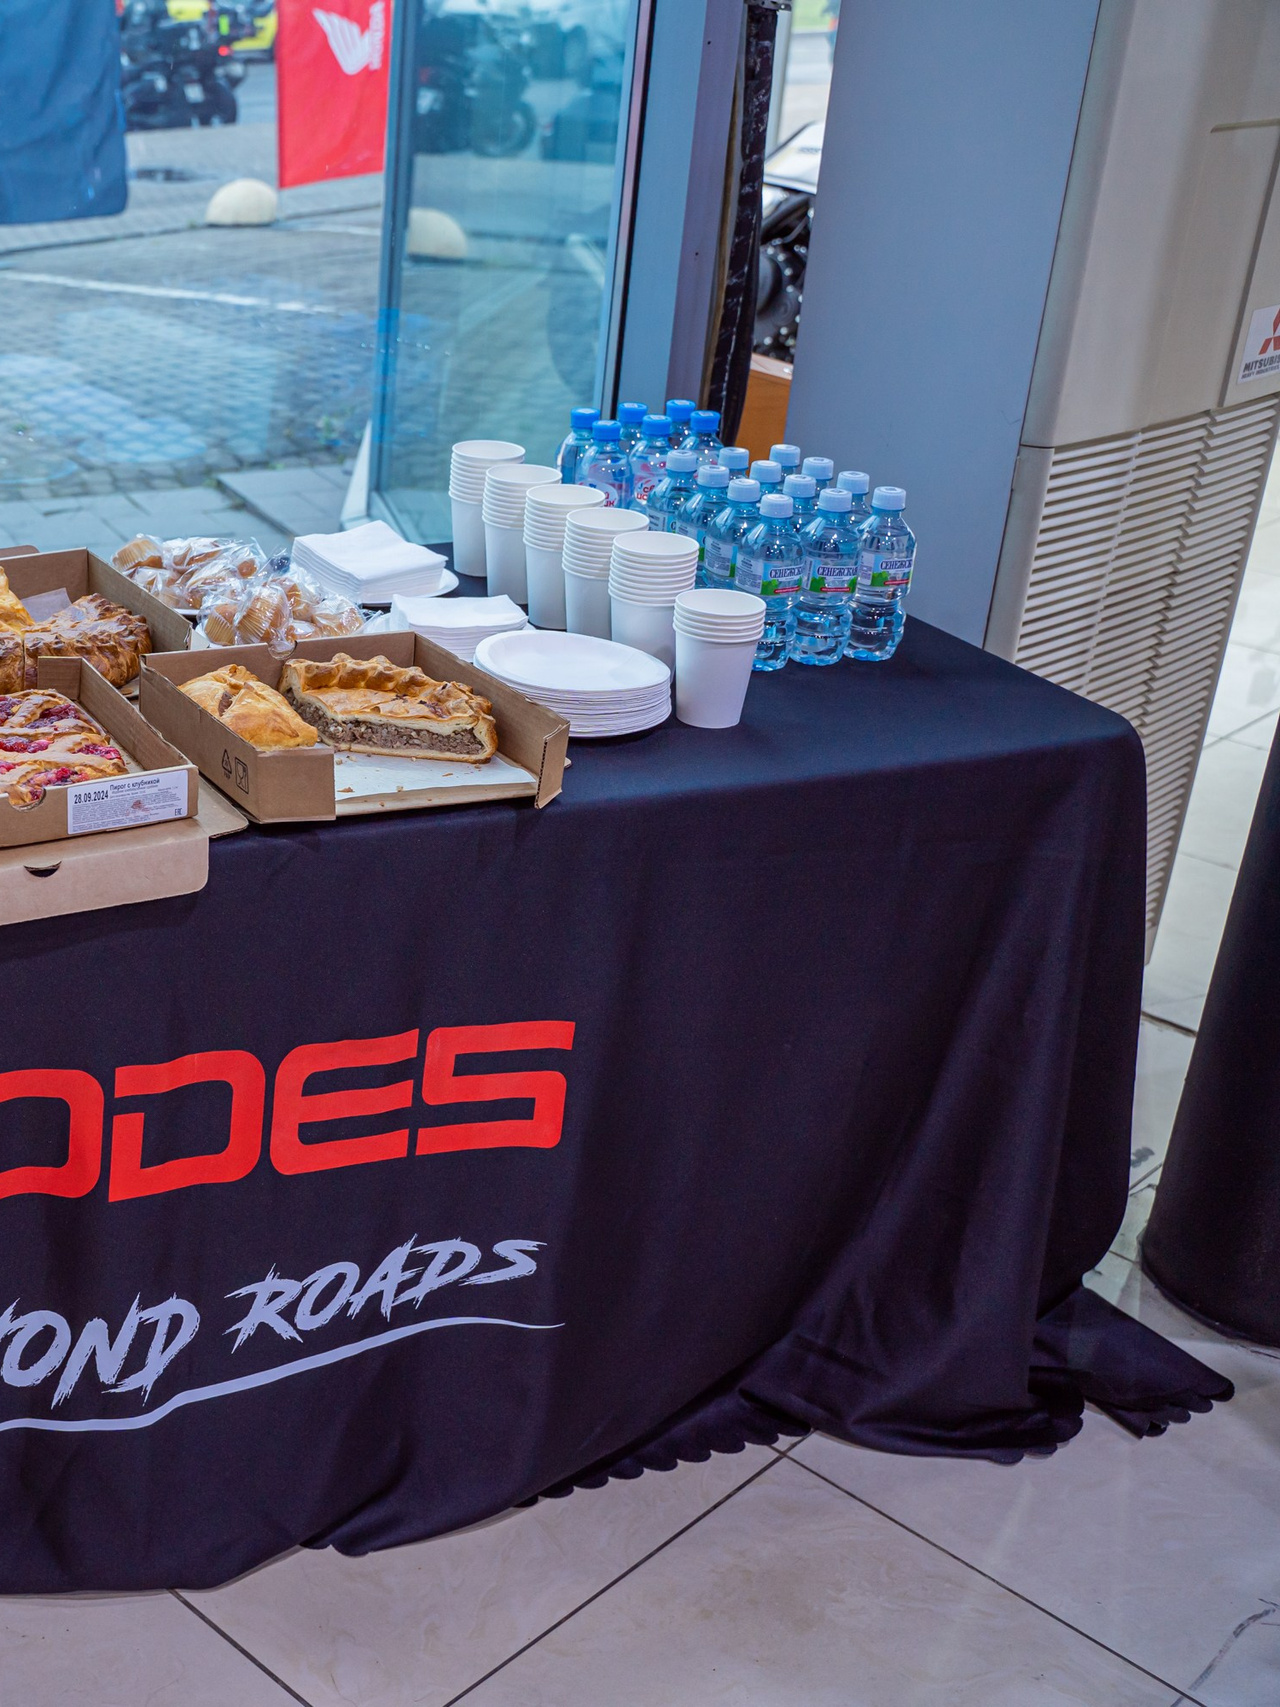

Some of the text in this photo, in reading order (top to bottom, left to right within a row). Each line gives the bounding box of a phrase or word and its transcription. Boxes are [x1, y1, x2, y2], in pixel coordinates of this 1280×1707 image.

[1243, 354, 1280, 373] MITSUBIS
[880, 559, 913, 570] СЕНЕЖСК
[770, 566, 803, 578] СЕНЕЖСК
[110, 783, 126, 791] Пирог
[131, 778, 160, 789] клубникой
[74, 790, 109, 804] 28.09.2024
[225, 1232, 548, 1353] ROADS
